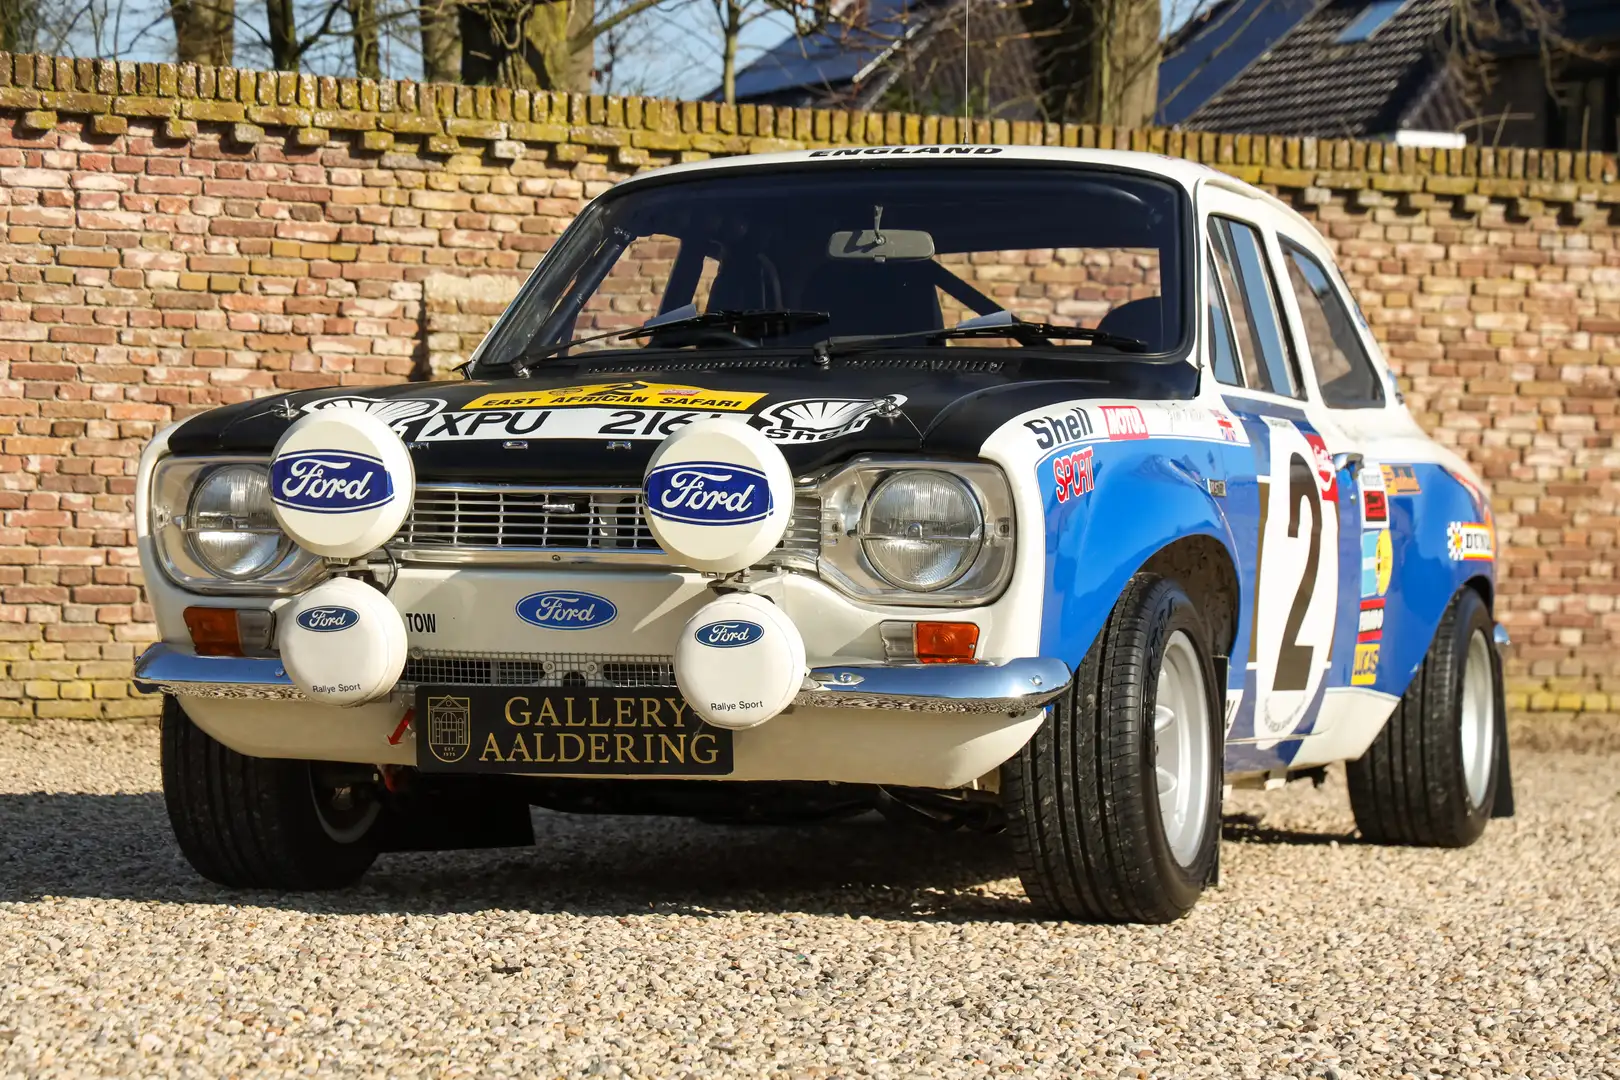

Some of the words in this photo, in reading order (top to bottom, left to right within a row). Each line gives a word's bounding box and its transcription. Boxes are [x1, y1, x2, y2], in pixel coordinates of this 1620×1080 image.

[808, 147, 1003, 157] ENGLAND
[482, 397, 540, 406] EAST
[549, 396, 649, 404] AFRICAN
[659, 397, 742, 407] SAFARI
[425, 411, 552, 437] XPU
[597, 410, 722, 435] 216
[765, 418, 871, 440] Shell
[1024, 407, 1093, 449] Shell
[1106, 407, 1146, 435] MOTUL
[282, 458, 373, 500] Ford
[1053, 446, 1095, 503] SPORT
[661, 471, 755, 512] Ford
[1272, 452, 1323, 691] 2
[308, 609, 346, 627] Ford
[535, 596, 595, 621] Ford
[406, 613, 436, 633] TOW
[708, 624, 750, 642] Ford
[312, 685, 336, 694] Rallye
[338, 683, 361, 693] Sport
[504, 696, 689, 728] GALLERY
[711, 702, 736, 712] Rallye
[738, 701, 763, 710] Sport
[478, 732, 719, 764] AALDERING
